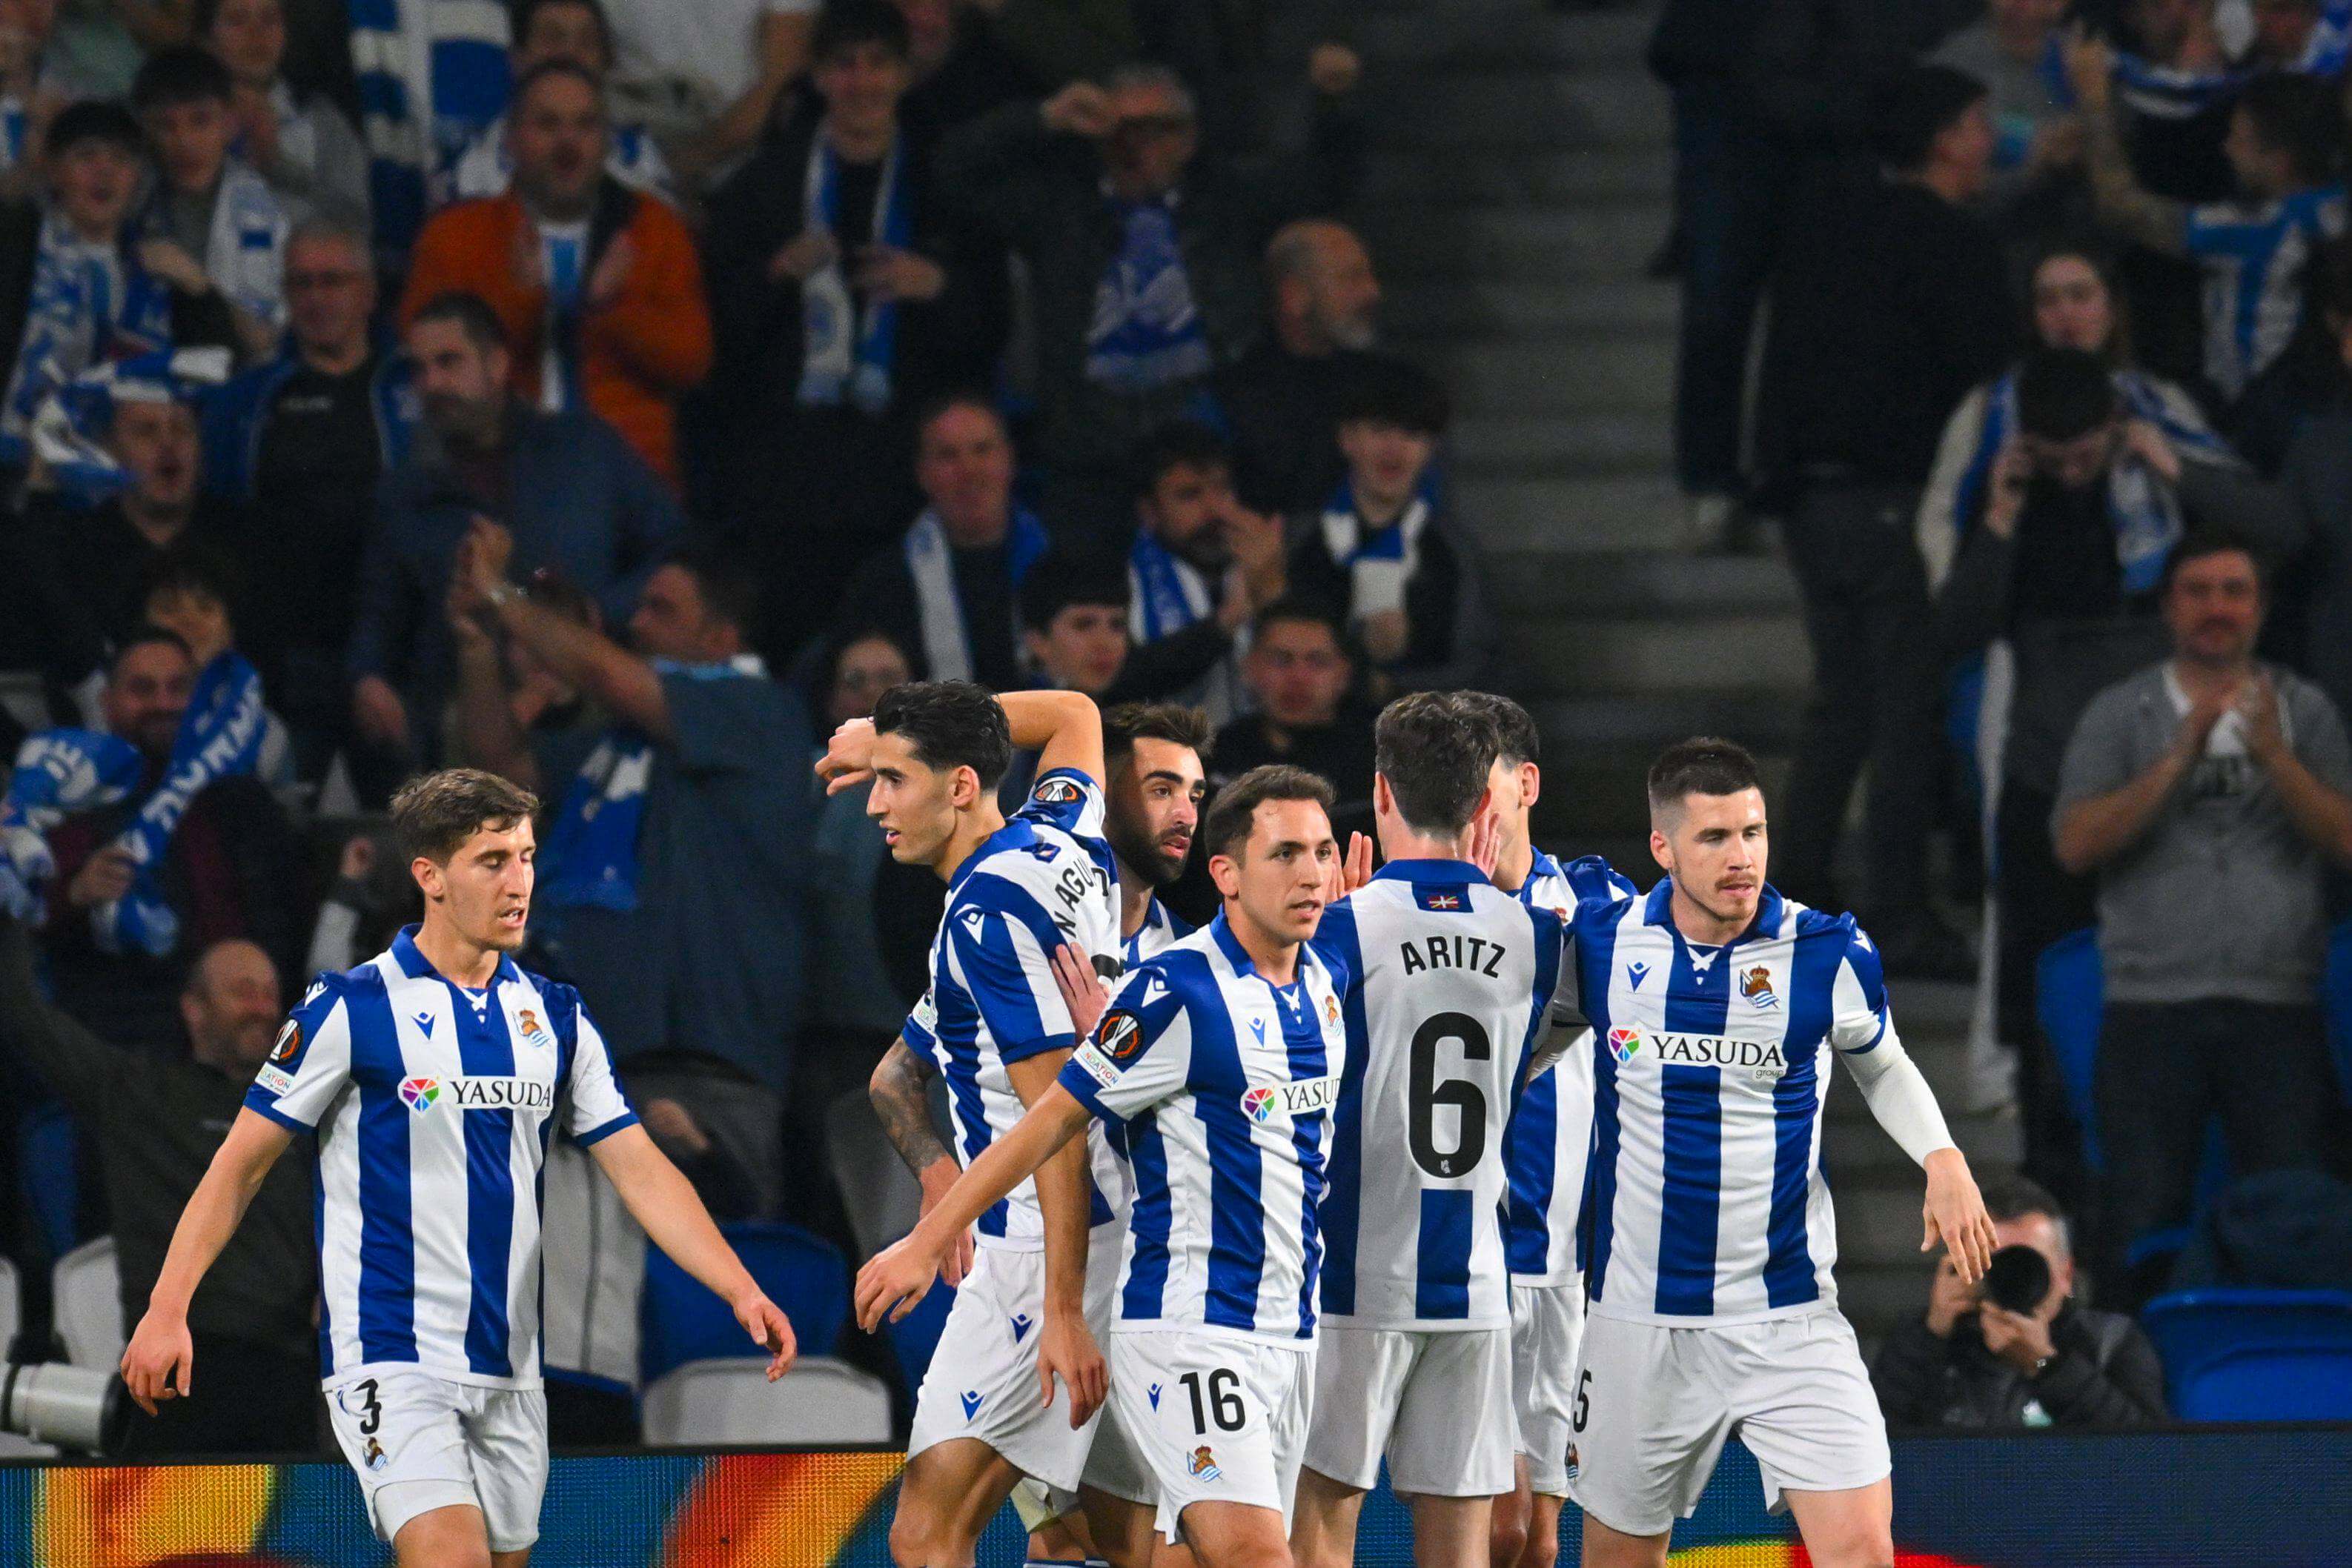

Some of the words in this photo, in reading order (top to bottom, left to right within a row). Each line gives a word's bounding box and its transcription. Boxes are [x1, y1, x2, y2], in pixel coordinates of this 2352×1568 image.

[1401, 935, 1505, 979] ARITZ
[1650, 1035, 1783, 1067] YASUDA
[1755, 1068, 1785, 1080] group
[449, 1080, 551, 1108] YASUDA
[1408, 1011, 1491, 1179] 6
[353, 1378, 382, 1435] 3
[1179, 1368, 1246, 1435] 16
[1573, 1368, 1592, 1433] 5
